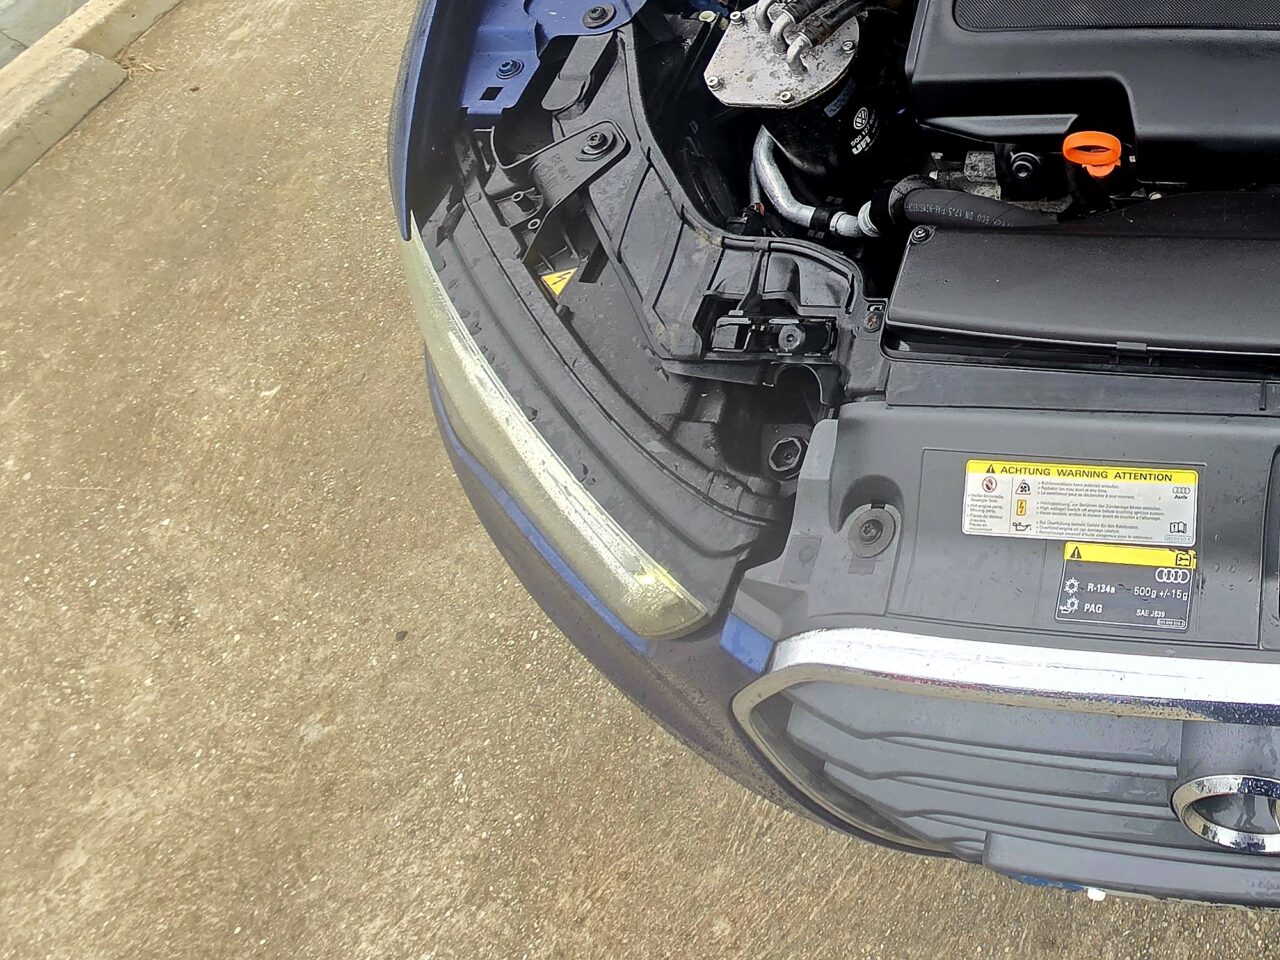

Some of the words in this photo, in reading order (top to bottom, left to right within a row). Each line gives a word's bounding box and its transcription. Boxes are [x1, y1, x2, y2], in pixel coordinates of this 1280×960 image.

[852, 136, 870, 154] UFI
[1000, 466, 1050, 476] ACHTUNG
[1057, 469, 1108, 479] WARNING
[1114, 472, 1172, 482] ATTENTION
[1087, 582, 1116, 594] R-134a
[1084, 603, 1102, 613] PAG
